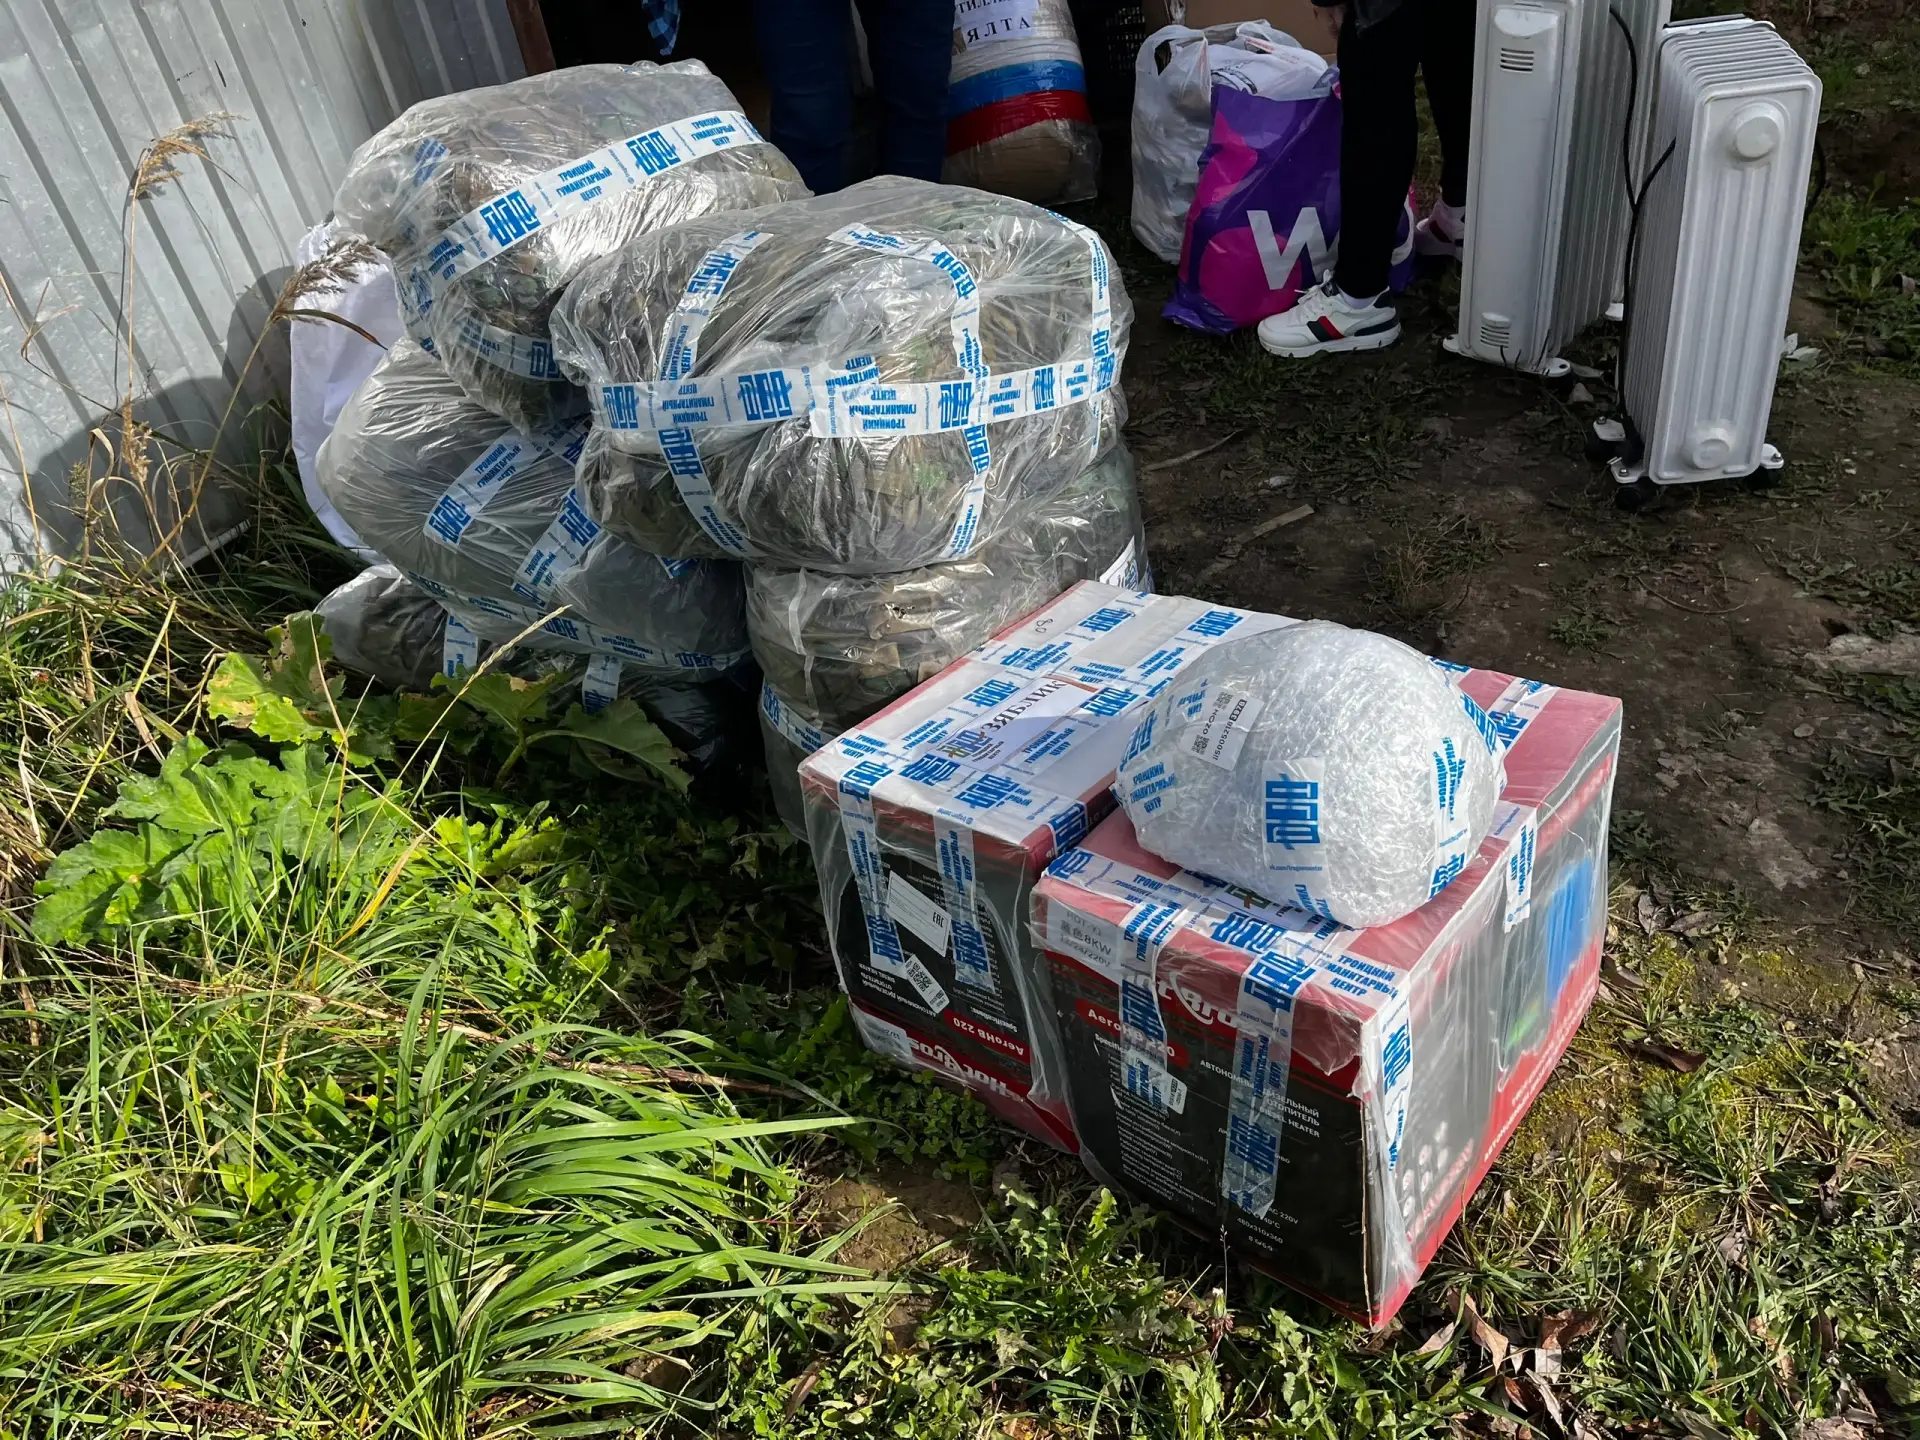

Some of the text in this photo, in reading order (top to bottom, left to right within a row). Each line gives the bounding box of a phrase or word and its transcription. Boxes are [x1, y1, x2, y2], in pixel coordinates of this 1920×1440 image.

[967, 17, 1031, 43] ЯЛТА
[556, 167, 612, 197] ГУМАНИТАРНЫЙ
[558, 160, 596, 182] ТРОИЦКИЙ
[580, 186, 602, 201] ЦЕНТР
[662, 397, 714, 411] ГУМАНИТАРНЫЙ
[849, 403, 917, 418] ГУМАНИТАРНЫЙ
[672, 413, 708, 424] ТРОИЦКИЙ
[863, 418, 906, 431] ТРОИЦКИЙ
[981, 680, 1067, 733] ЗЯБЛИК
[1203, 709, 1219, 735] OZON
[1123, 904, 1159, 942] ТРОИЦКИЙ
[1338, 954, 1395, 982] ТРОИЦКИЙ
[1330, 977, 1368, 997] ЦЕНТР
[953, 1017, 1024, 1057] AeroHB 220
[1288, 1120, 1320, 1138] HEATER
